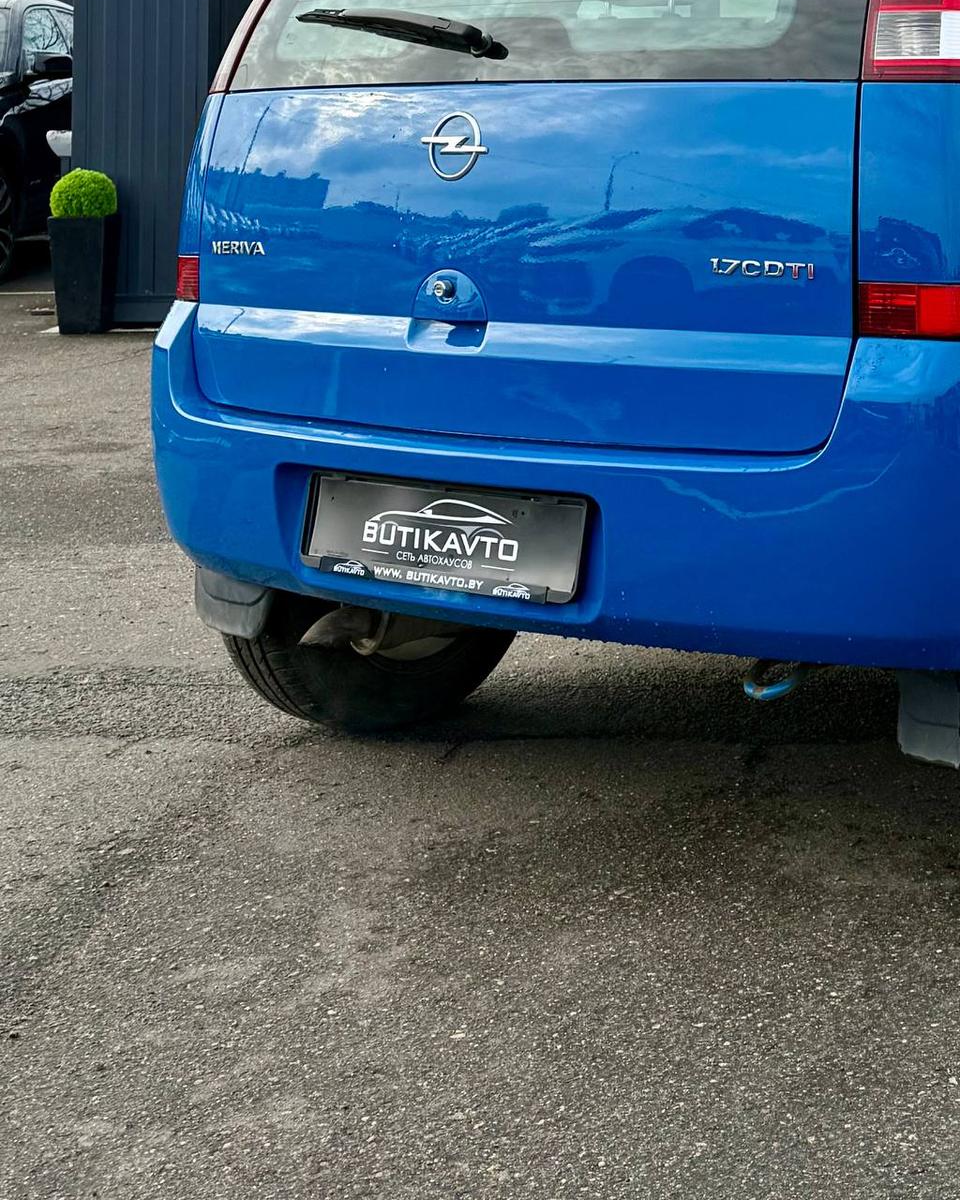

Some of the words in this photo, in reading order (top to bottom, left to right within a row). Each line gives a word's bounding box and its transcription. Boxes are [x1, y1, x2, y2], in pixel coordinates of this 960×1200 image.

[211, 240, 266, 256] MERIVA
[362, 520, 519, 562] BUTIKAVTO
[396, 550, 415, 562] СЕТЬ
[417, 553, 473, 569] АВТОХАУСОВ
[406, 571, 484, 590] BUTIKAVTO.BY
